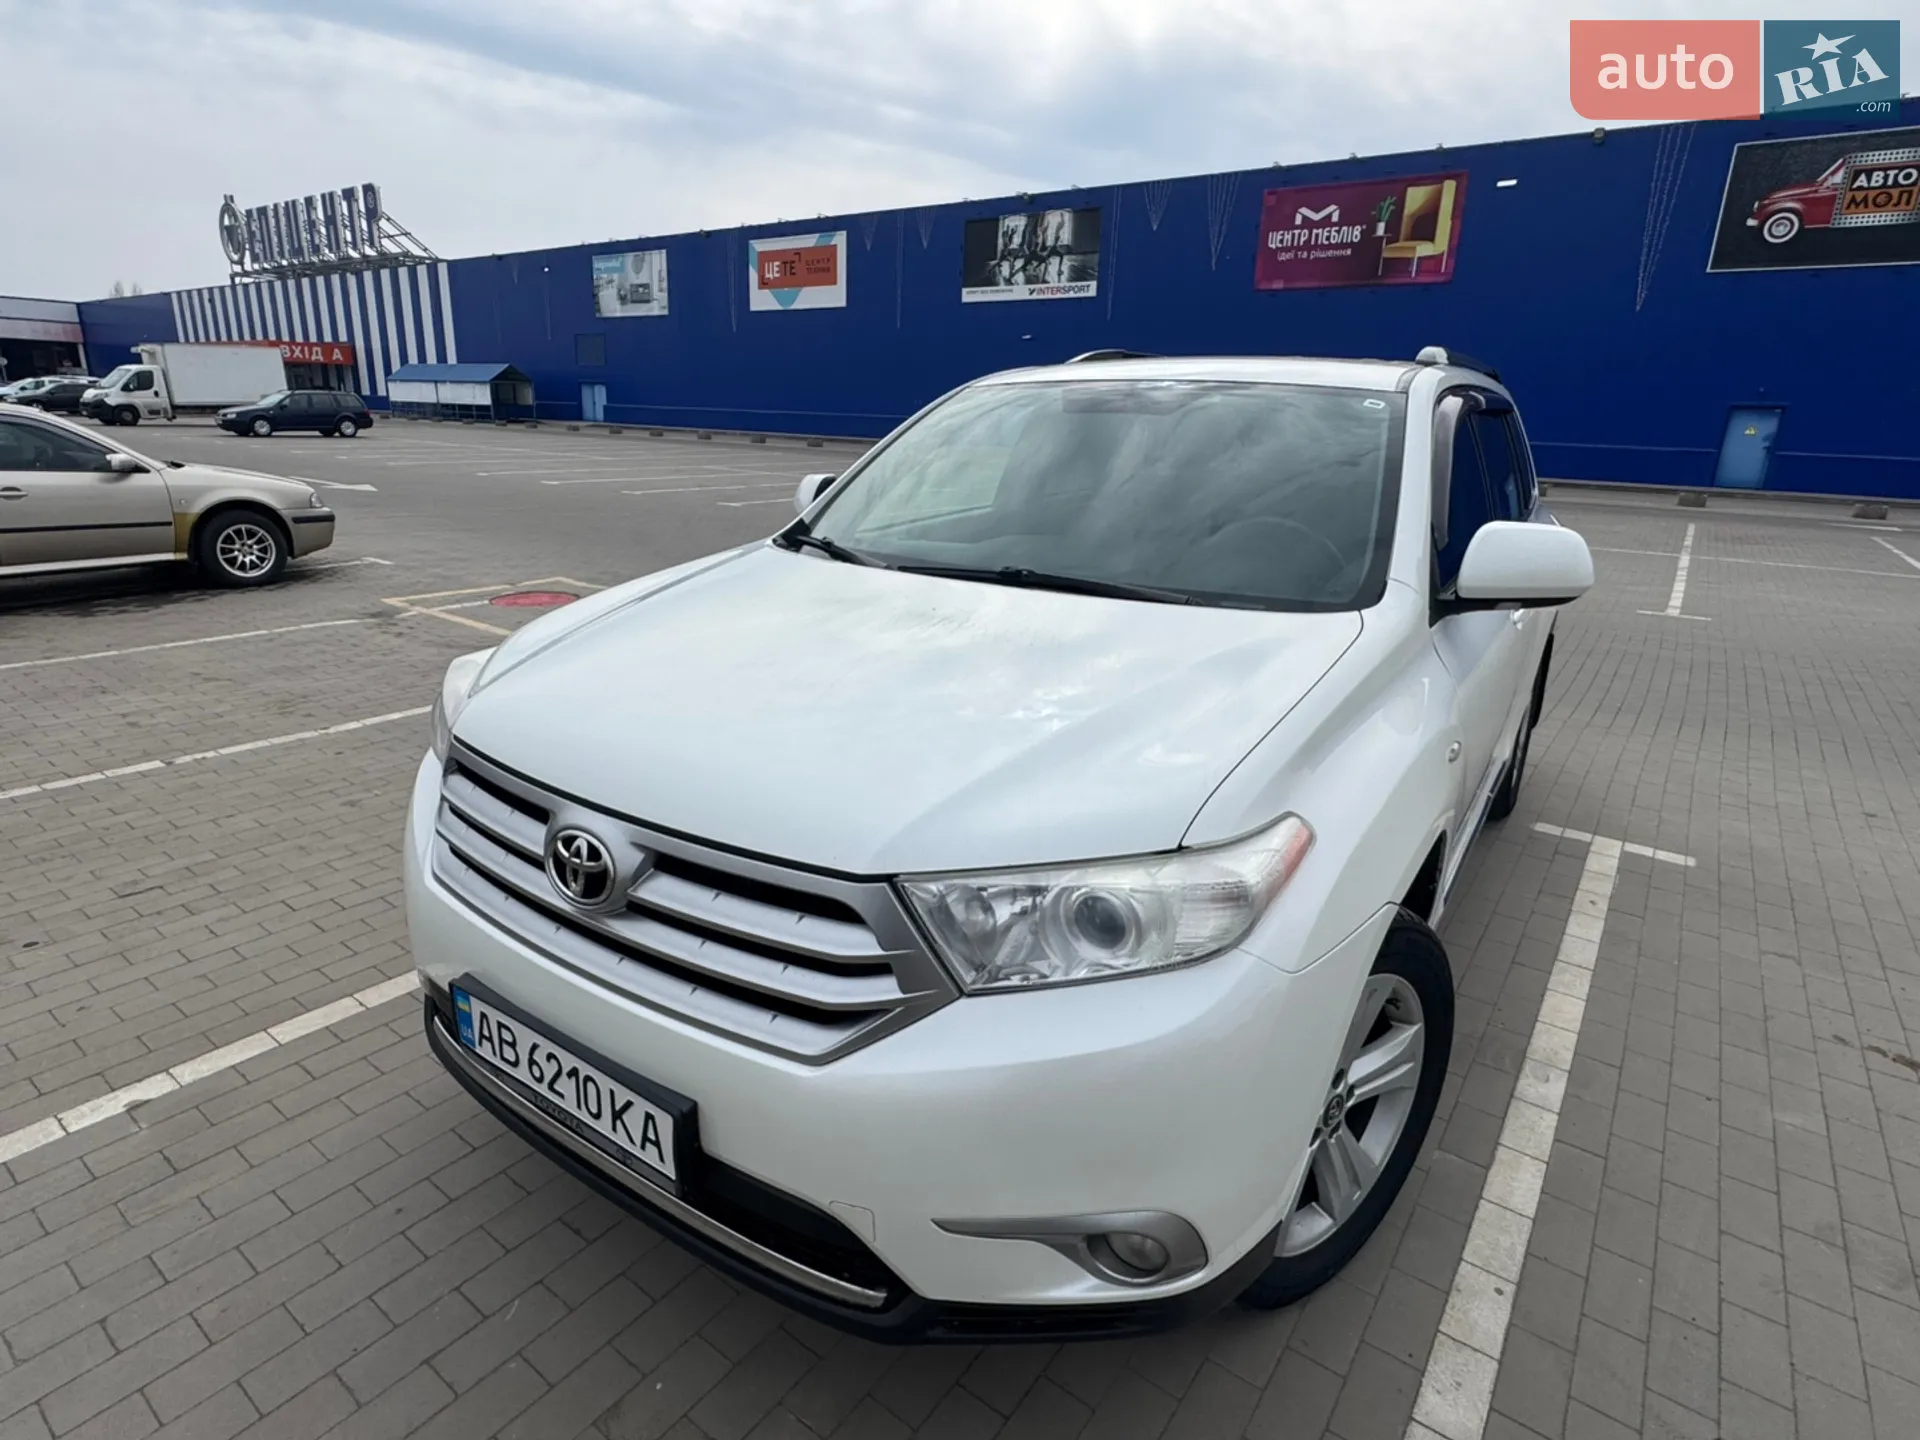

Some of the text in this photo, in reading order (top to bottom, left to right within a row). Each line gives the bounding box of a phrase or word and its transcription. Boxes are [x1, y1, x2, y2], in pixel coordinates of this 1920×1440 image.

[1852, 167, 1919, 189] АВТО
[1845, 190, 1914, 211] МОЛ
[1267, 225, 1362, 249] ЦЕНТР МЕБЛІВ
[1297, 250, 1308, 259] та
[1309, 248, 1352, 260] рішення
[1036, 284, 1090, 295] INTERSPORT
[279, 344, 324, 362] ВХІД
[527, 1041, 603, 1121] 6210
